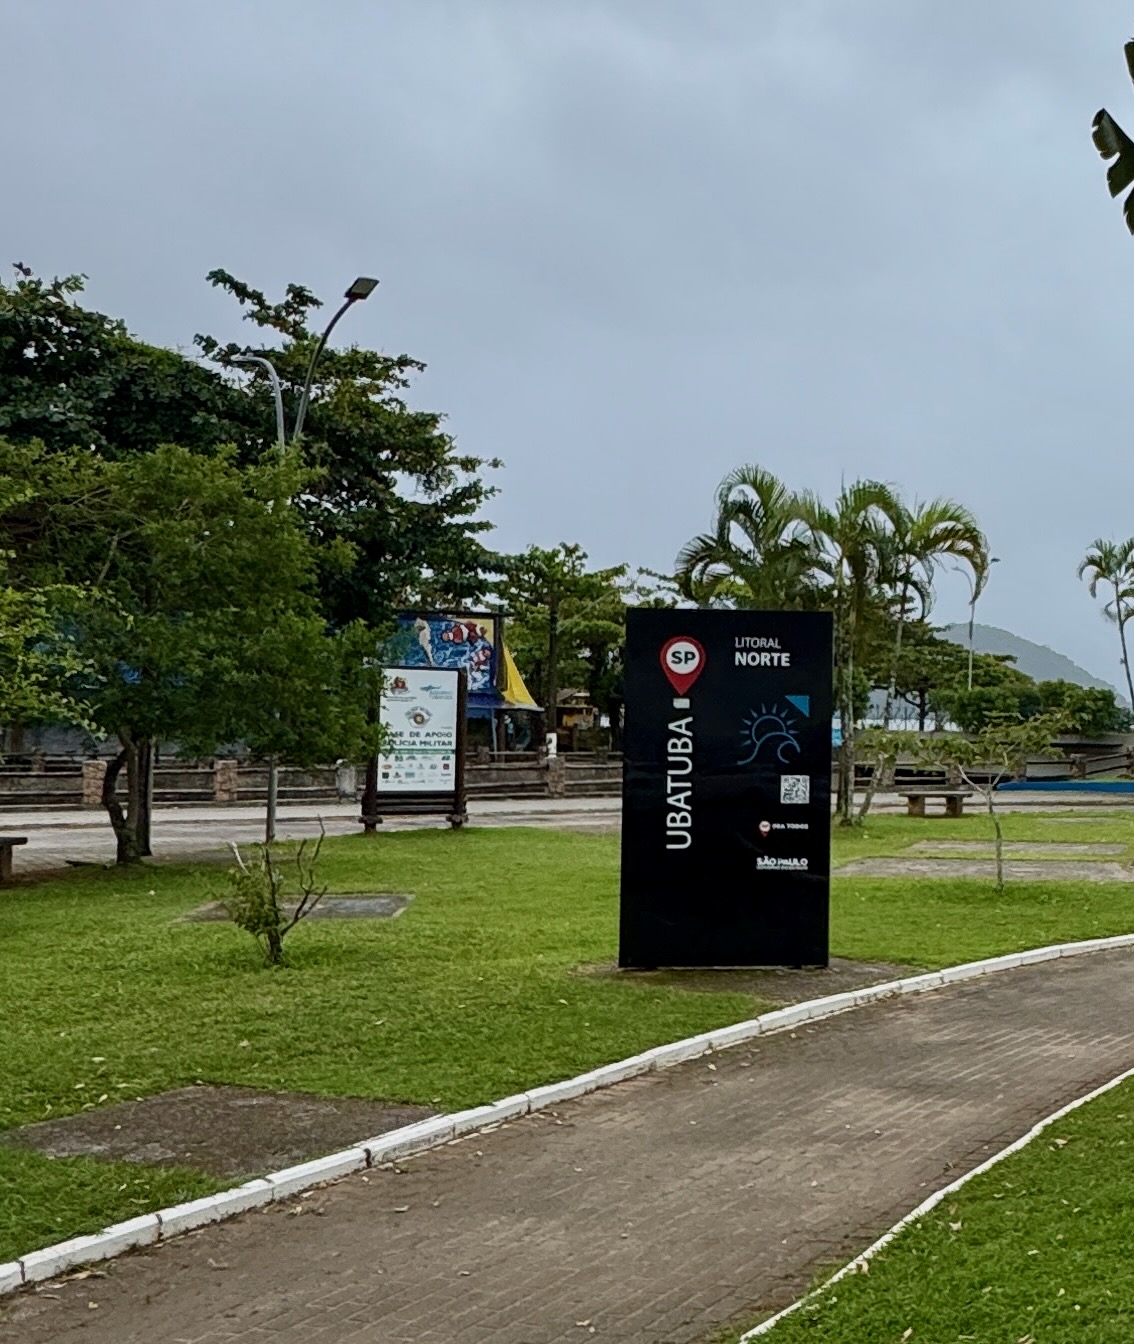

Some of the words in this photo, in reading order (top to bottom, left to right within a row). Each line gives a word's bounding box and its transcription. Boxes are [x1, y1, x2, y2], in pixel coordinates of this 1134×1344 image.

[734, 637, 782, 649] LITORAL
[671, 650, 696, 665] SP
[734, 652, 791, 667] NORTE
[665, 716, 694, 850] UBATUBA
